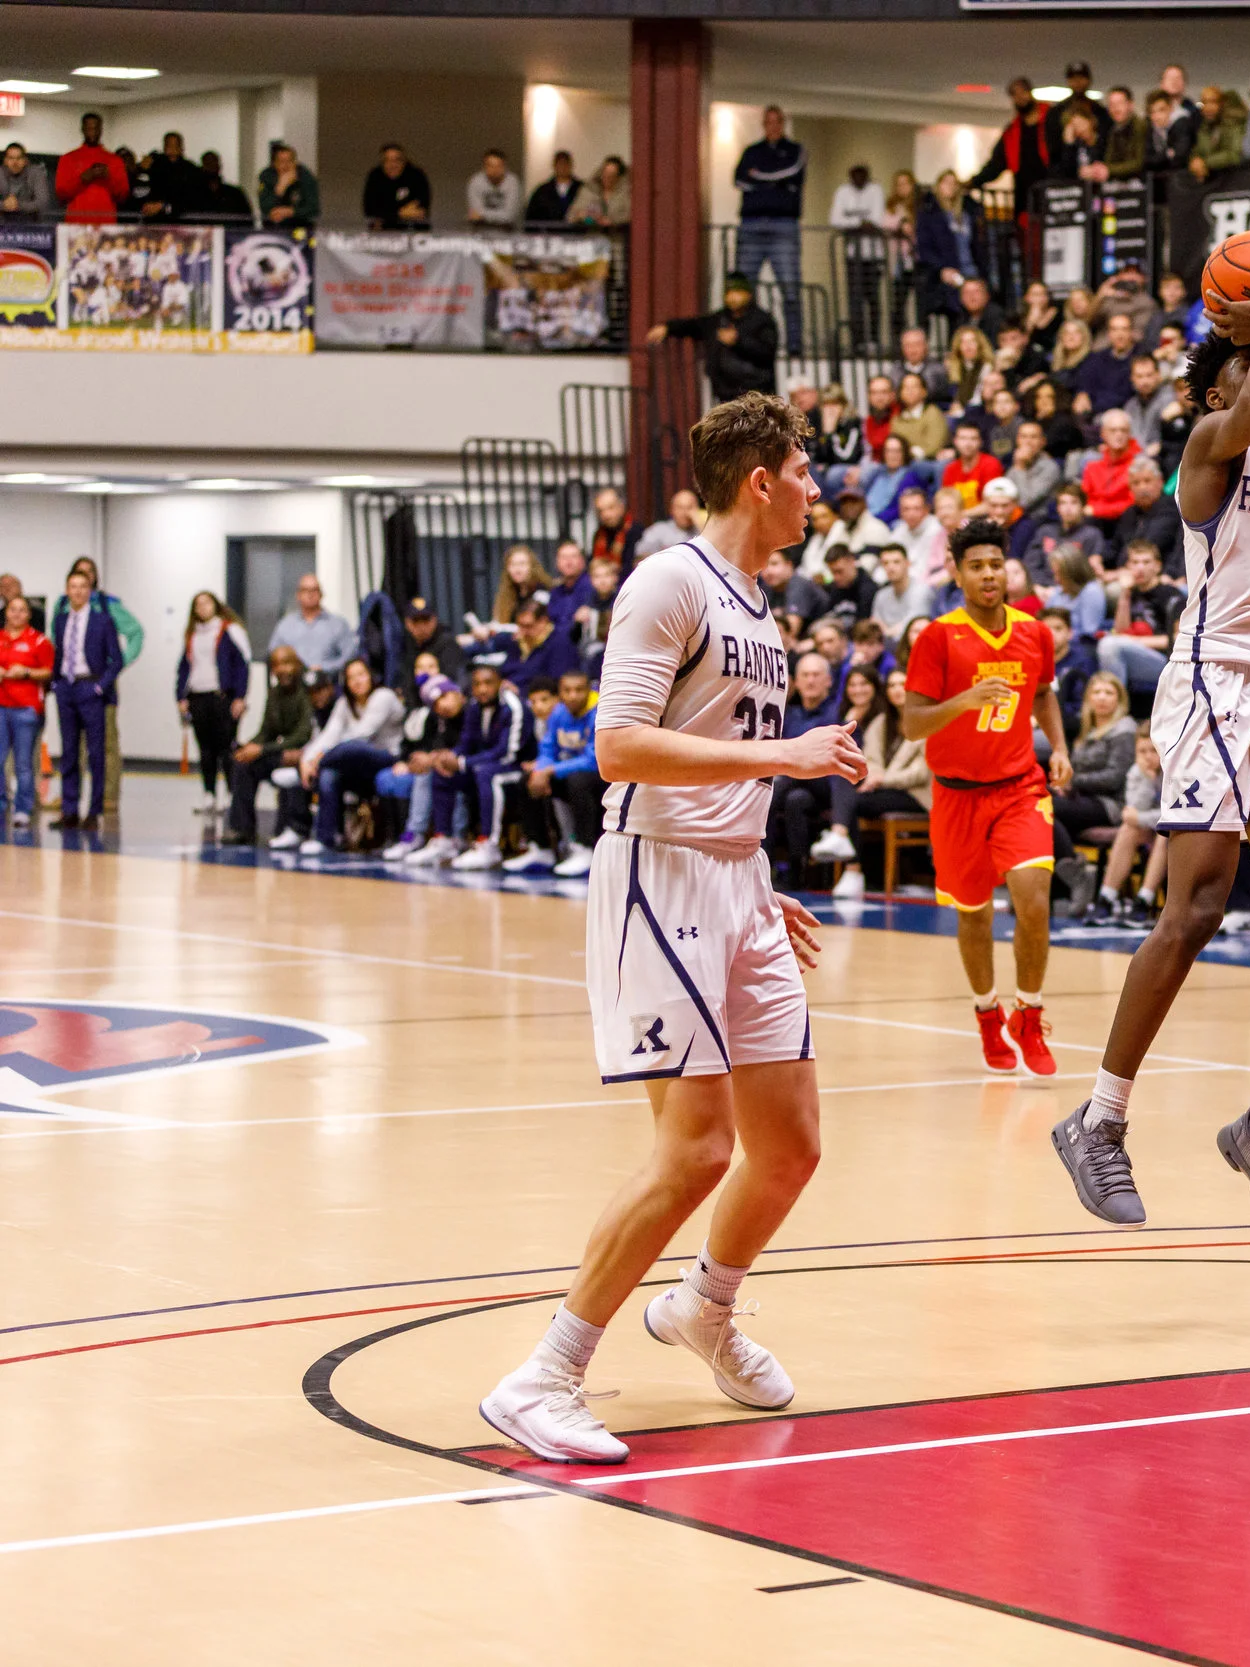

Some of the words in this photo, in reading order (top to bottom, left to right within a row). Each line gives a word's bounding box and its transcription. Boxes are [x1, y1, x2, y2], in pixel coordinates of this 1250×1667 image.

[232, 305, 302, 331] 2014
[720, 634, 787, 691] RANNE
[975, 691, 1020, 733] 13
